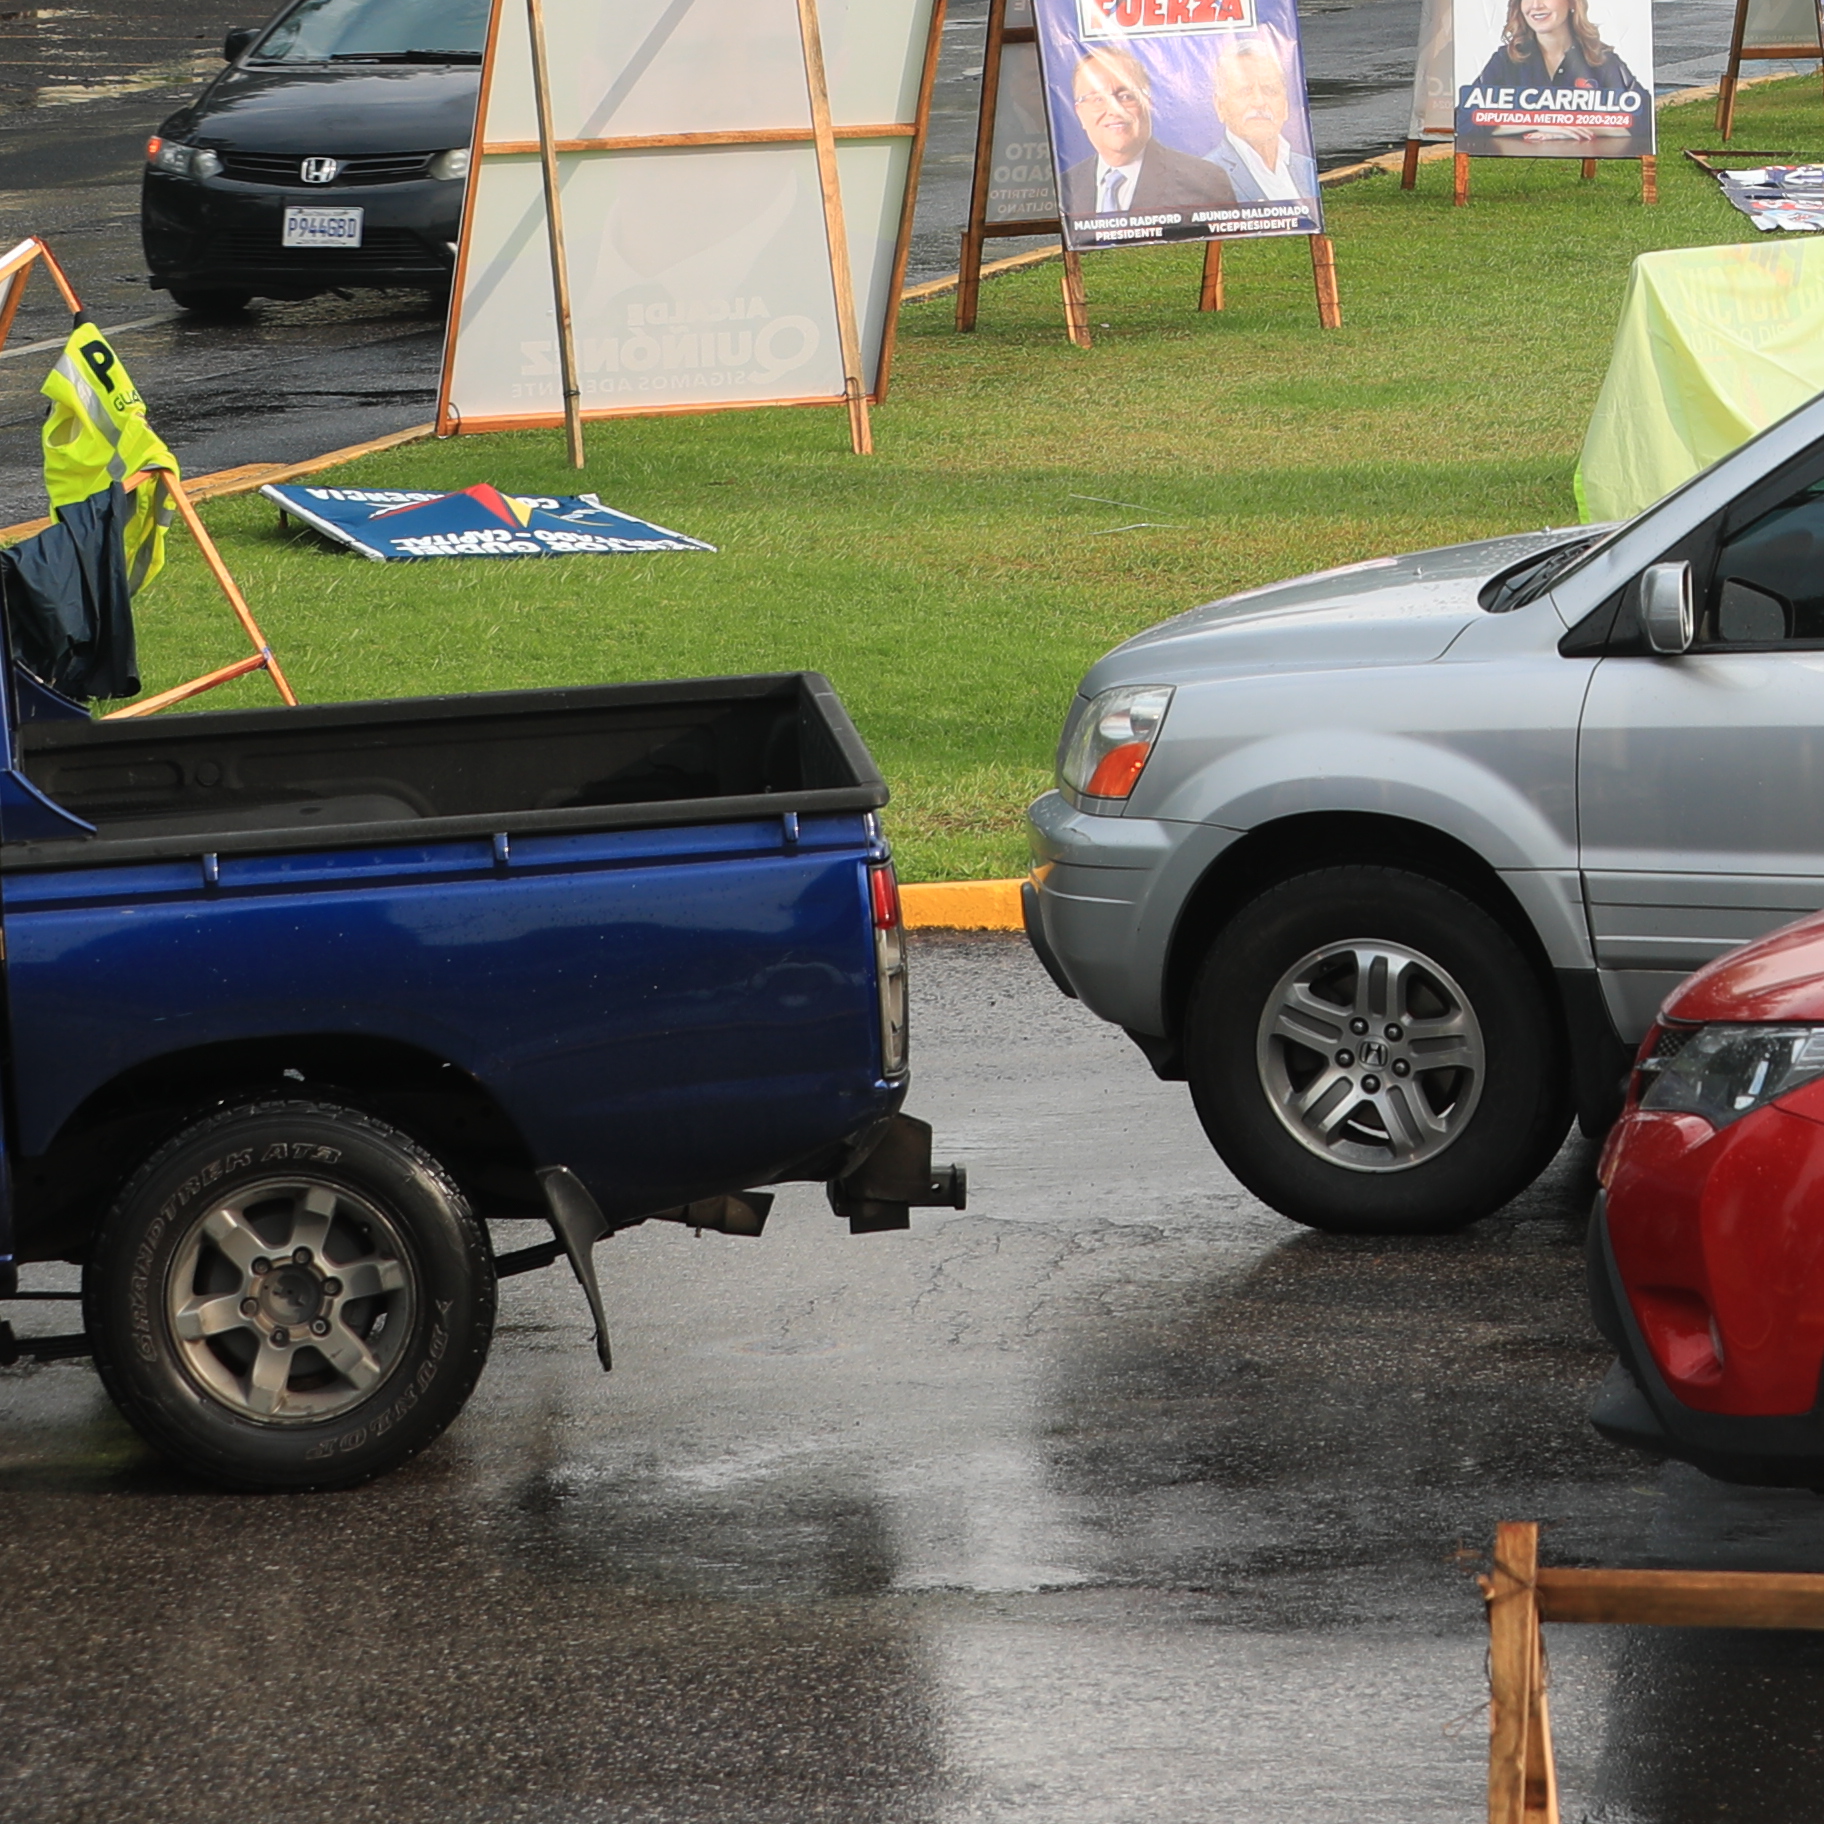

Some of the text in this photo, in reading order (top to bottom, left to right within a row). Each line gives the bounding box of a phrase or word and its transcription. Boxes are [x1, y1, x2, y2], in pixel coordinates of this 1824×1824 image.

[1464, 86, 1641, 113] ALE CARRILLO
[1475, 112, 1631, 126] DIPUTADA METRO 2020-2024
[1073, 204, 1309, 232] MAURICIO RADFORD ABUNDIO MALDONADO
[1095, 217, 1299, 243] PRESIDENTE VICEPRESIDENTE
[134, 1142, 343, 1363] GRANDTREK AT3
[304, 1323, 452, 1461] DUNLOP
